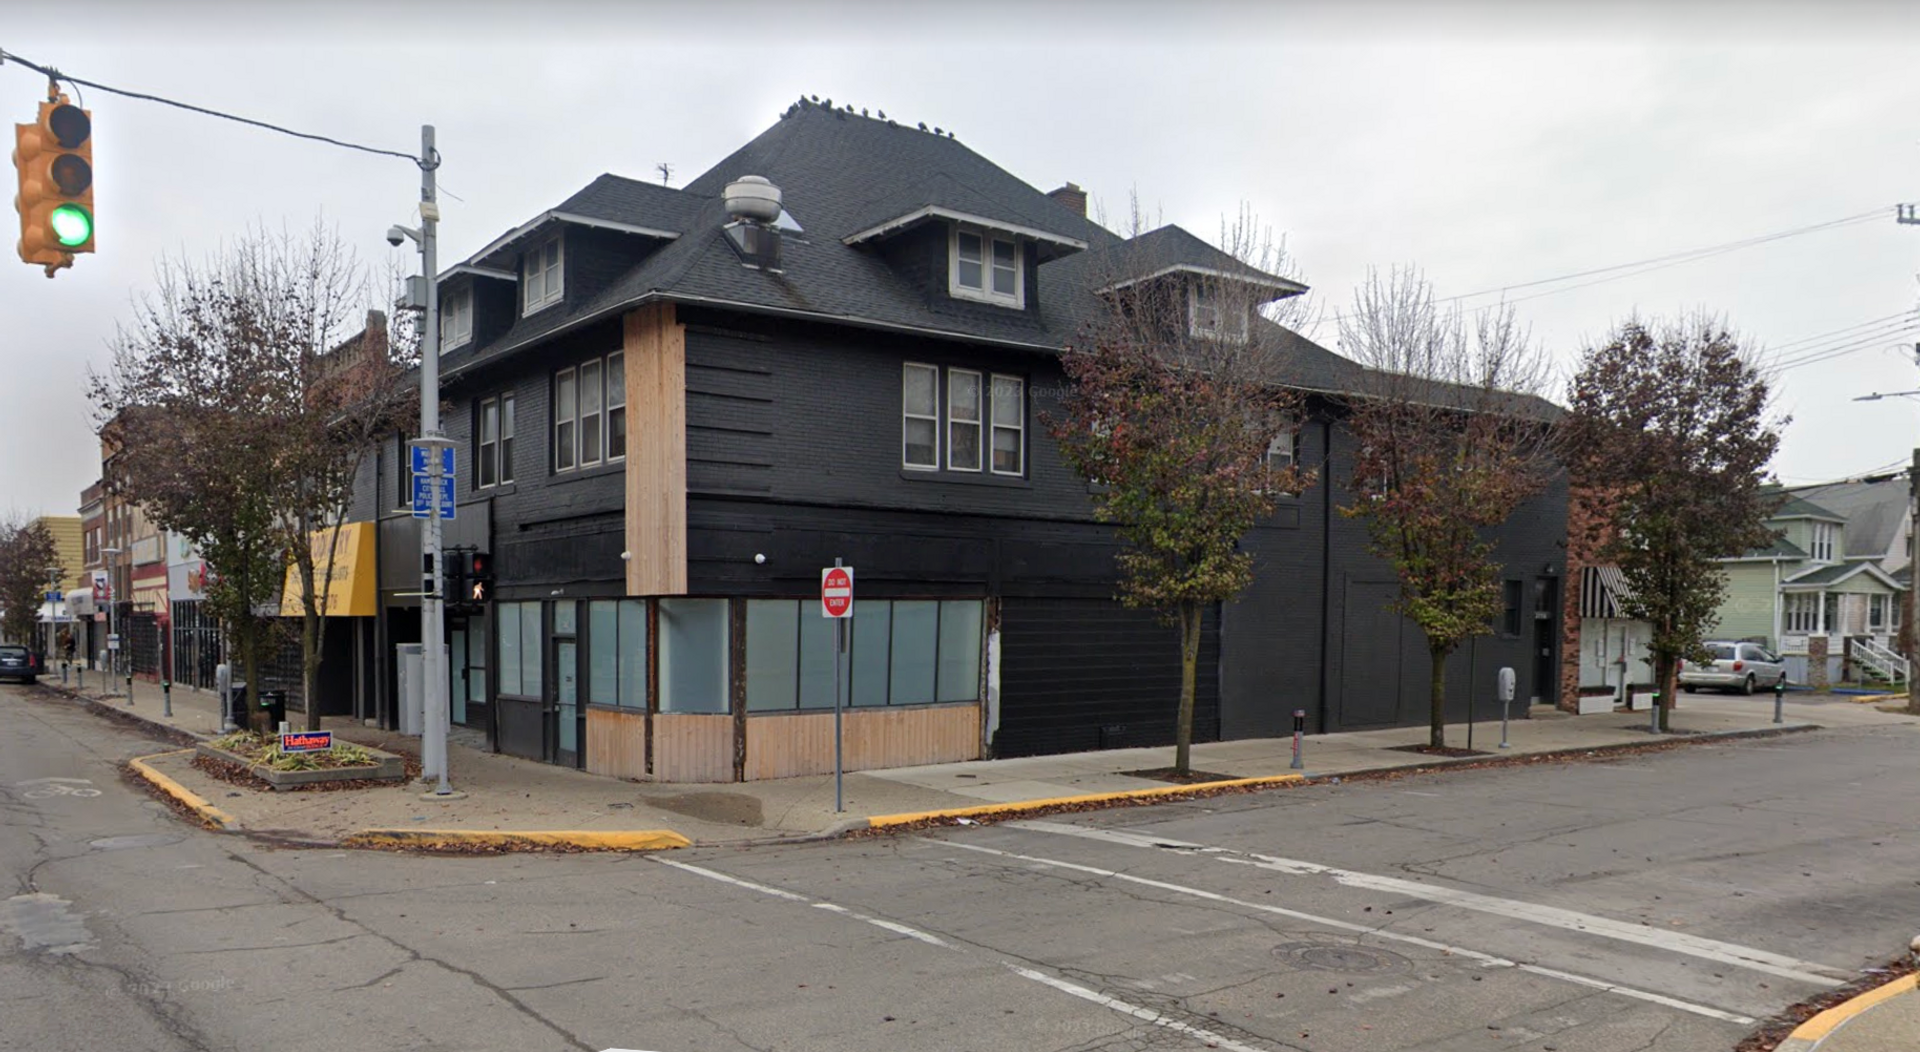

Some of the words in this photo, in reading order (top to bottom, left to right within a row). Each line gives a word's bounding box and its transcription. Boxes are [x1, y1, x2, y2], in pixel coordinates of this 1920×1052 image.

[421, 478, 448, 486] HAMCK
[829, 598, 845, 607] ENTER
[285, 735, 329, 746] Hathaway
